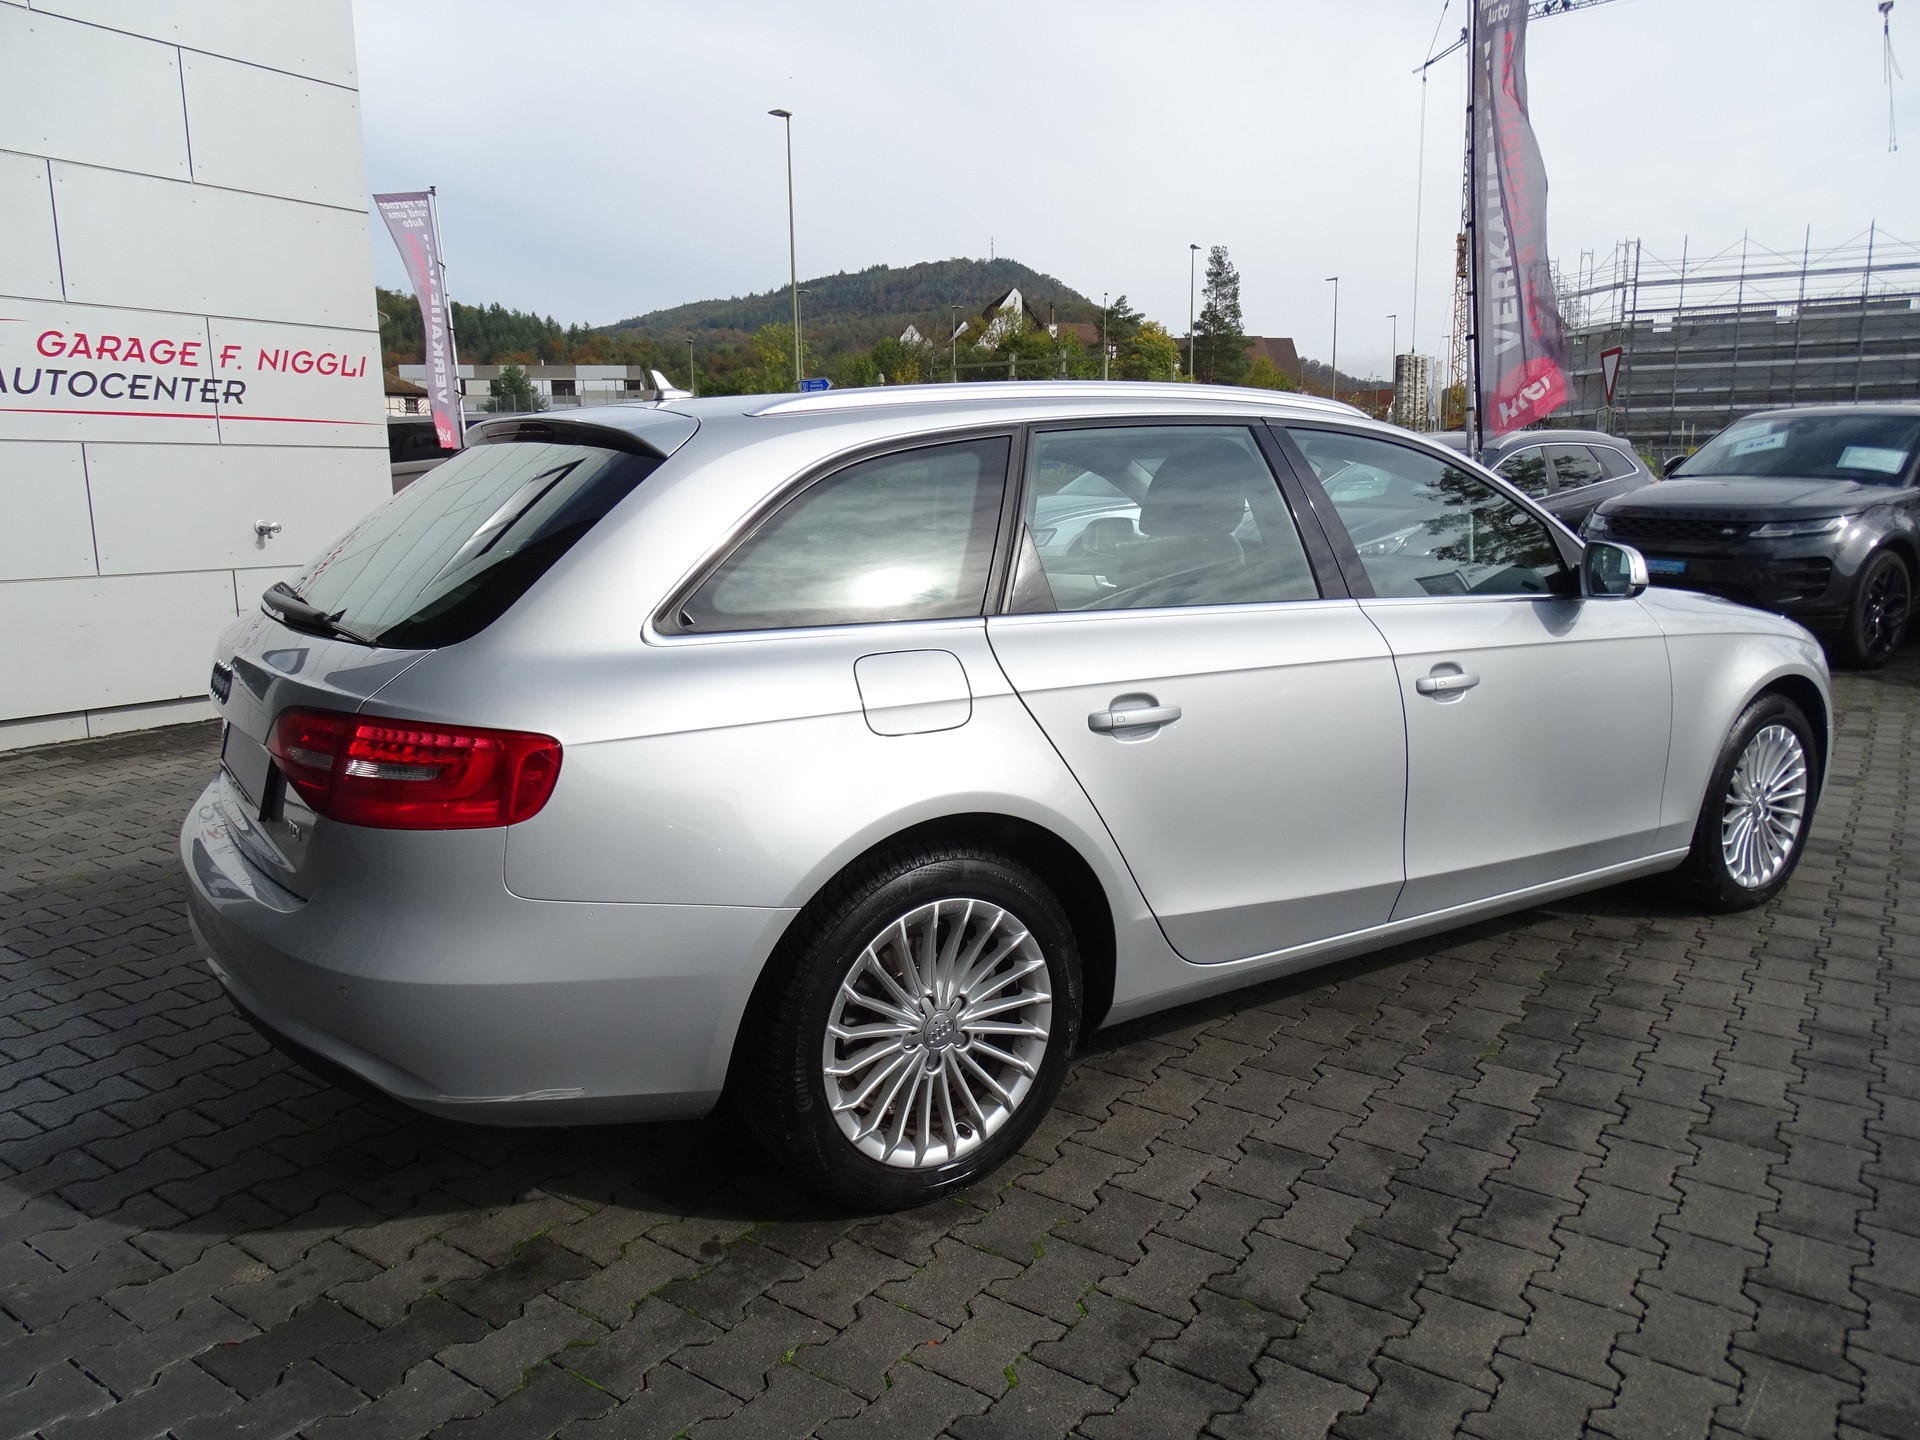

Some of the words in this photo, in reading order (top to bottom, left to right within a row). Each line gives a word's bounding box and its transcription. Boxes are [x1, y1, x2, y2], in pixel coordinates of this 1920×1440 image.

[1486, 4, 1510, 27] Auto
[36, 330, 202, 366] GARAGE
[219, 345, 243, 370] F.
[257, 348, 367, 378] NIGGLI
